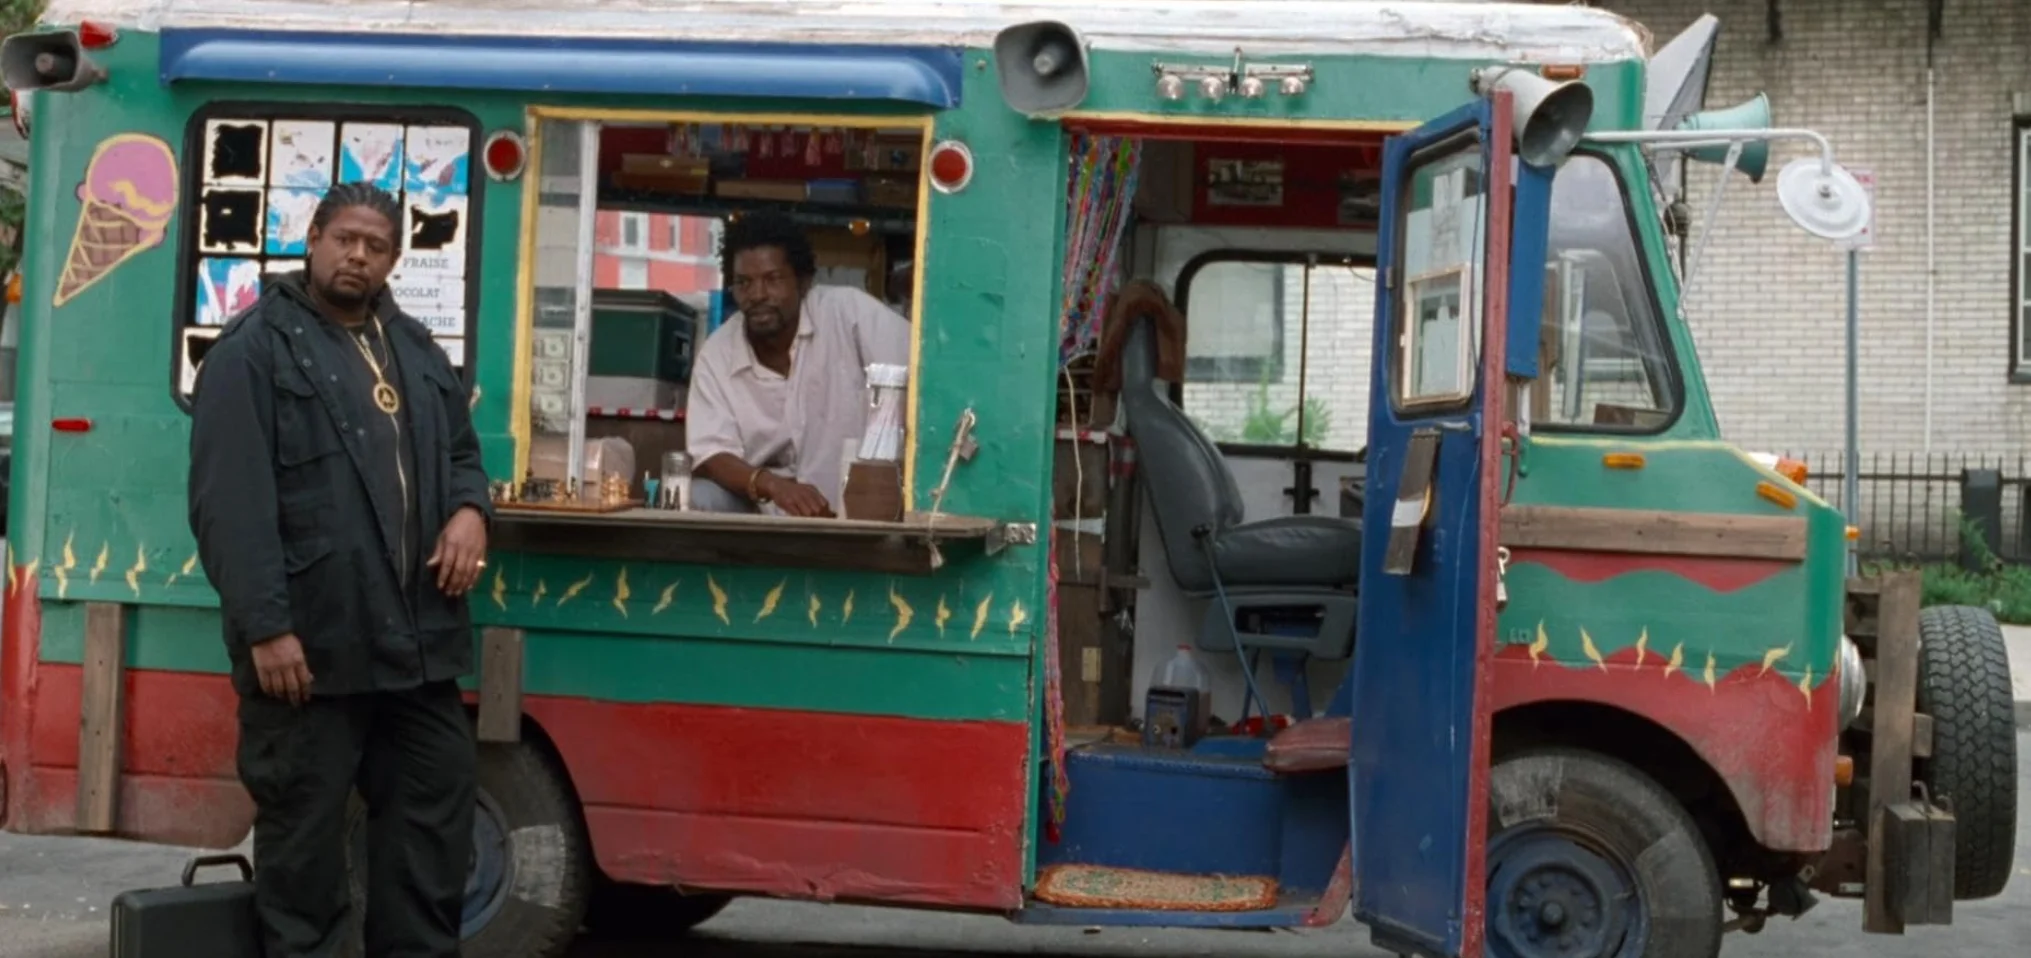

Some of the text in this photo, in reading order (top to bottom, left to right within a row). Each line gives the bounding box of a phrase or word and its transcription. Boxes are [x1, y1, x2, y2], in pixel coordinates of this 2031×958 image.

[403, 257, 449, 269] FRAISE
[394, 287, 441, 298] OCOLAT
[421, 316, 456, 328] ACHE
